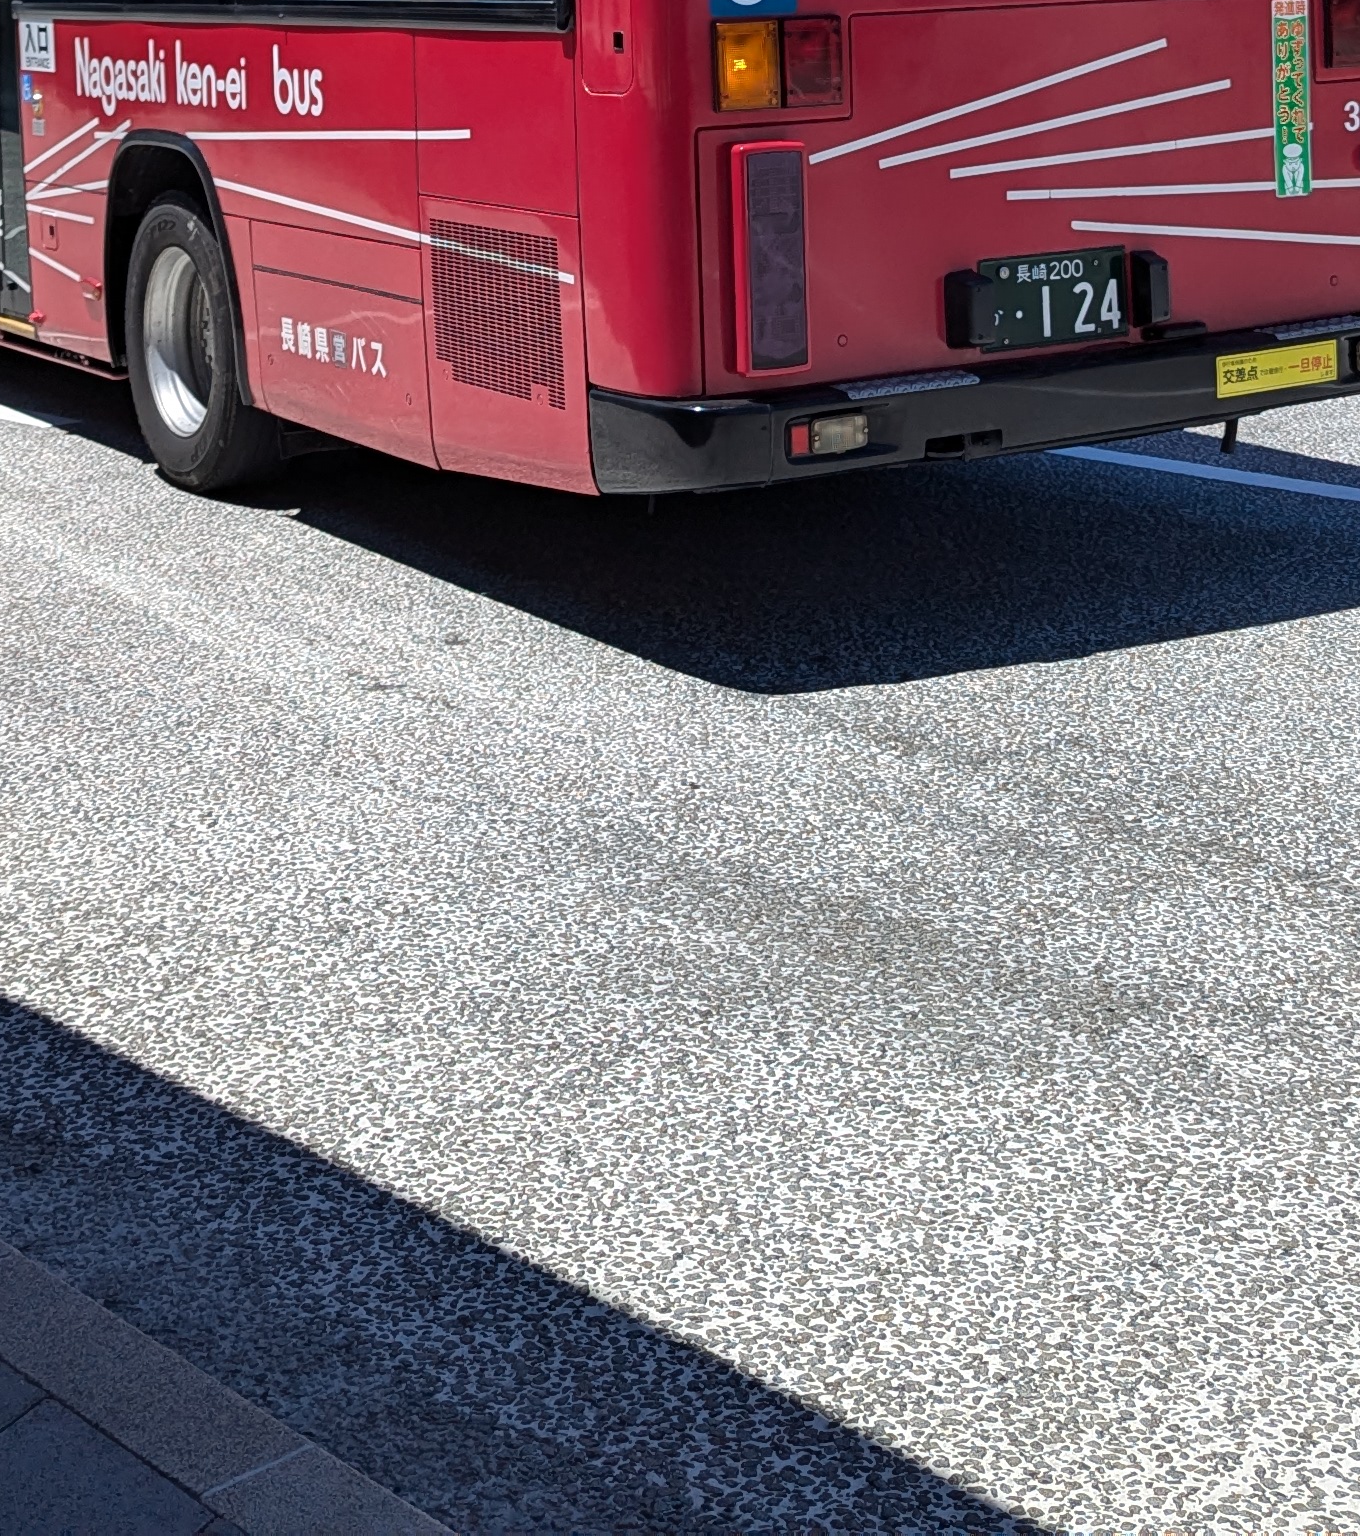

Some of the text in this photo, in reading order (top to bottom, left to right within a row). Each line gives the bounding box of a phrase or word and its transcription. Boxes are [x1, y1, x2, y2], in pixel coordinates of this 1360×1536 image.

[25, 24, 49, 53] 入口
[74, 37, 323, 116] Nagasaki ken-ei bus
[1016, 259, 1083, 283] 長崎 200
[281, 316, 387, 378] 長崎県営バス
[1222, 366, 1258, 385] 交差点
[1288, 354, 1333, 373] 一旦停止
